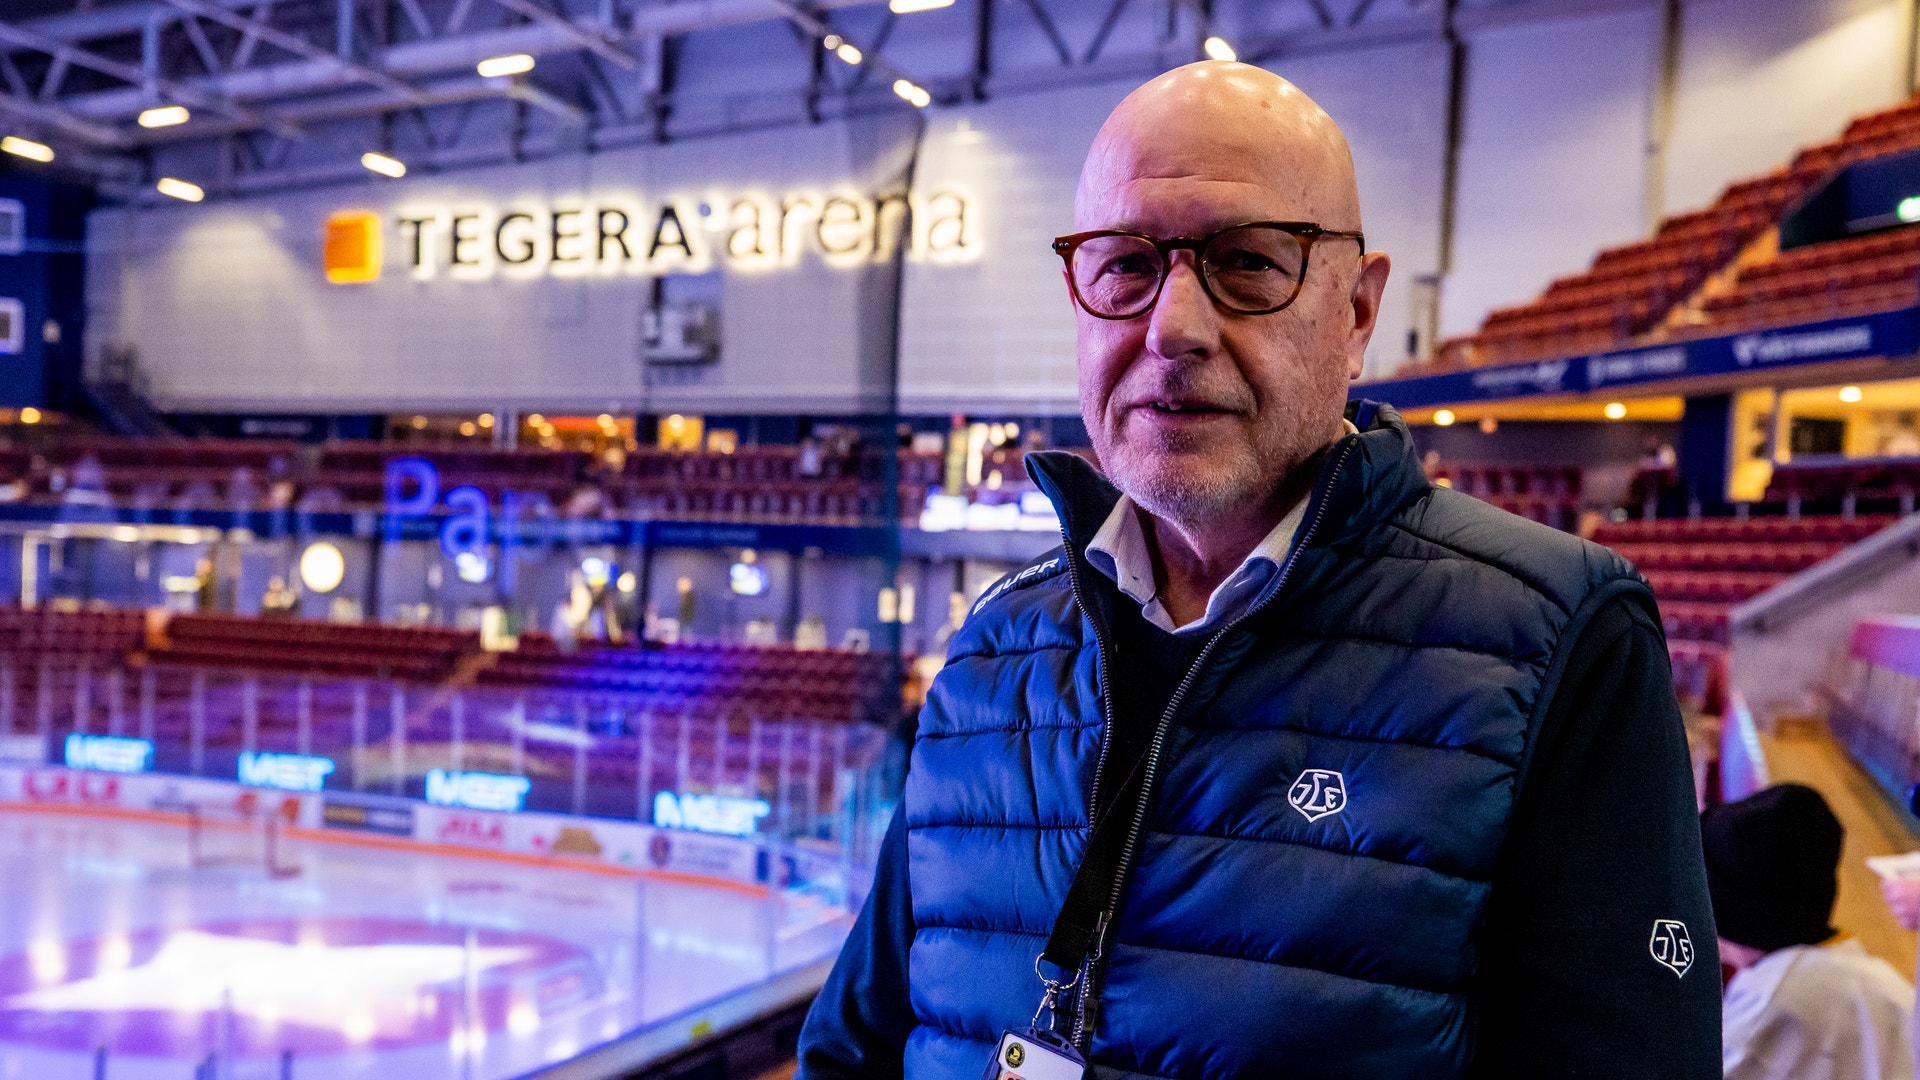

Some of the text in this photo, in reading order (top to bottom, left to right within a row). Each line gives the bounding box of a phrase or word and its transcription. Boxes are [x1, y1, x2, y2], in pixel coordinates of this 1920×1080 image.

[400, 188, 980, 270] TEGERA arena
[972, 557, 1060, 616] BAUER
